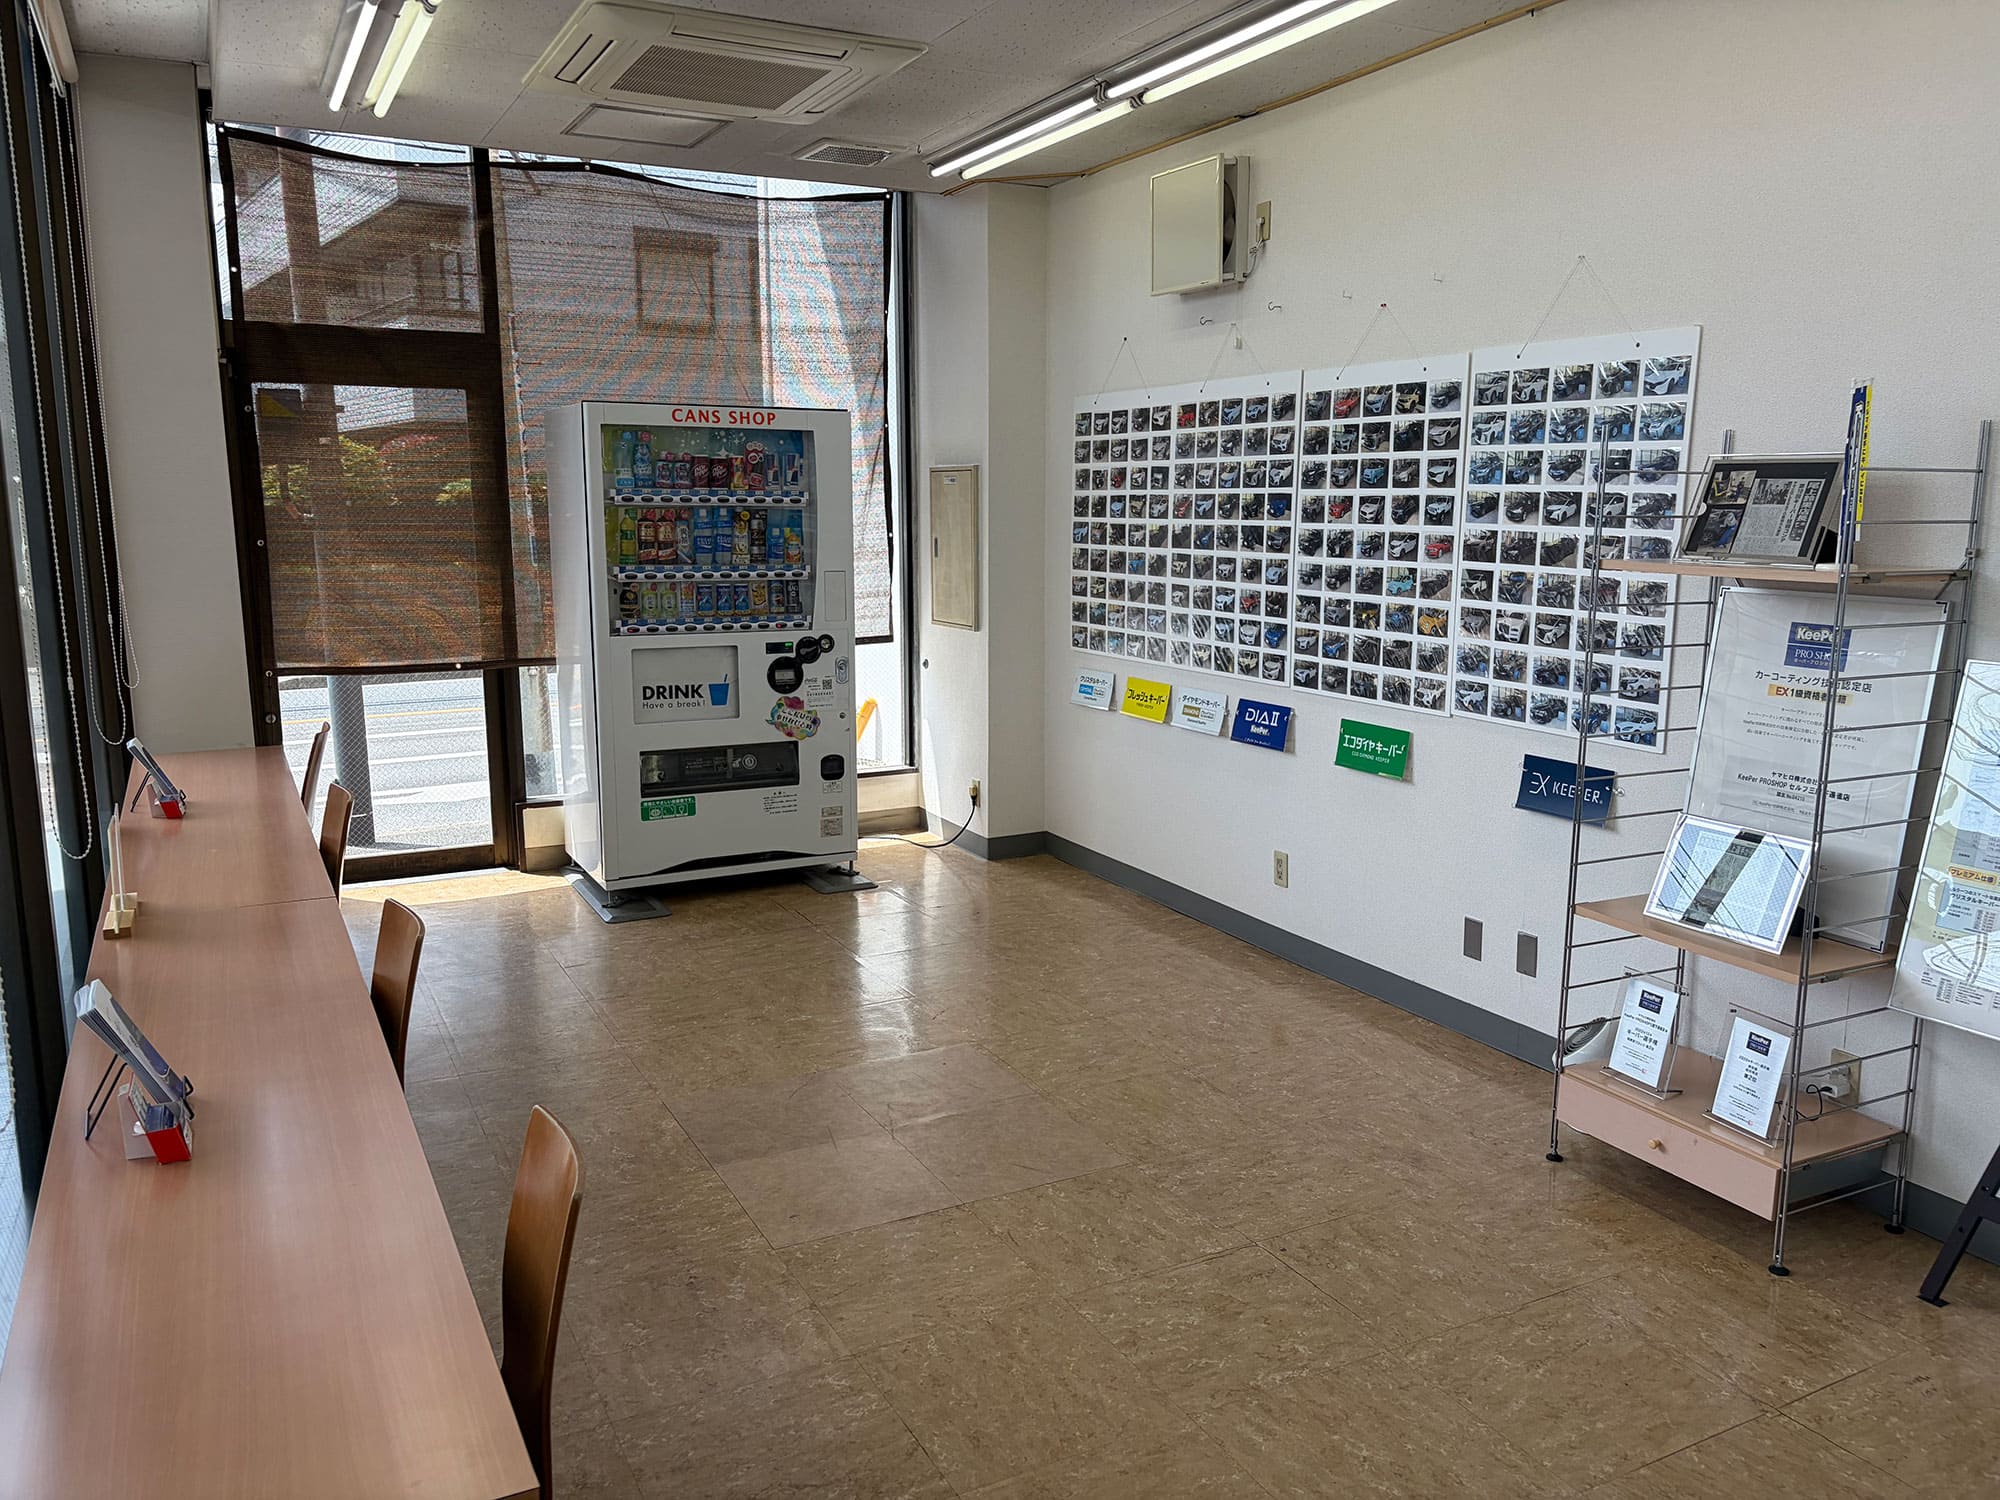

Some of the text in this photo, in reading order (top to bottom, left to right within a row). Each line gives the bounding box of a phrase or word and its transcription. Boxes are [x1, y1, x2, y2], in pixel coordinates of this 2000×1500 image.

[671, 408, 776, 426] CANS SHOP
[1796, 626, 1845, 644] KeeP
[1794, 648, 1813, 660] PRO
[642, 684, 704, 701] DRINK
[1127, 688, 1166, 705] フレッシュキーパー
[1775, 686, 1847, 705] EX1級資格者籍
[642, 702, 664, 710] Have
[1181, 694, 1221, 709] ダイヤモンドキーパー
[1343, 734, 1403, 758] エコダイヤキーパー
[1737, 773, 1758, 783] KeePer
[1759, 776, 1788, 789] PROSHOP
[1552, 781, 1601, 804] KEEER
